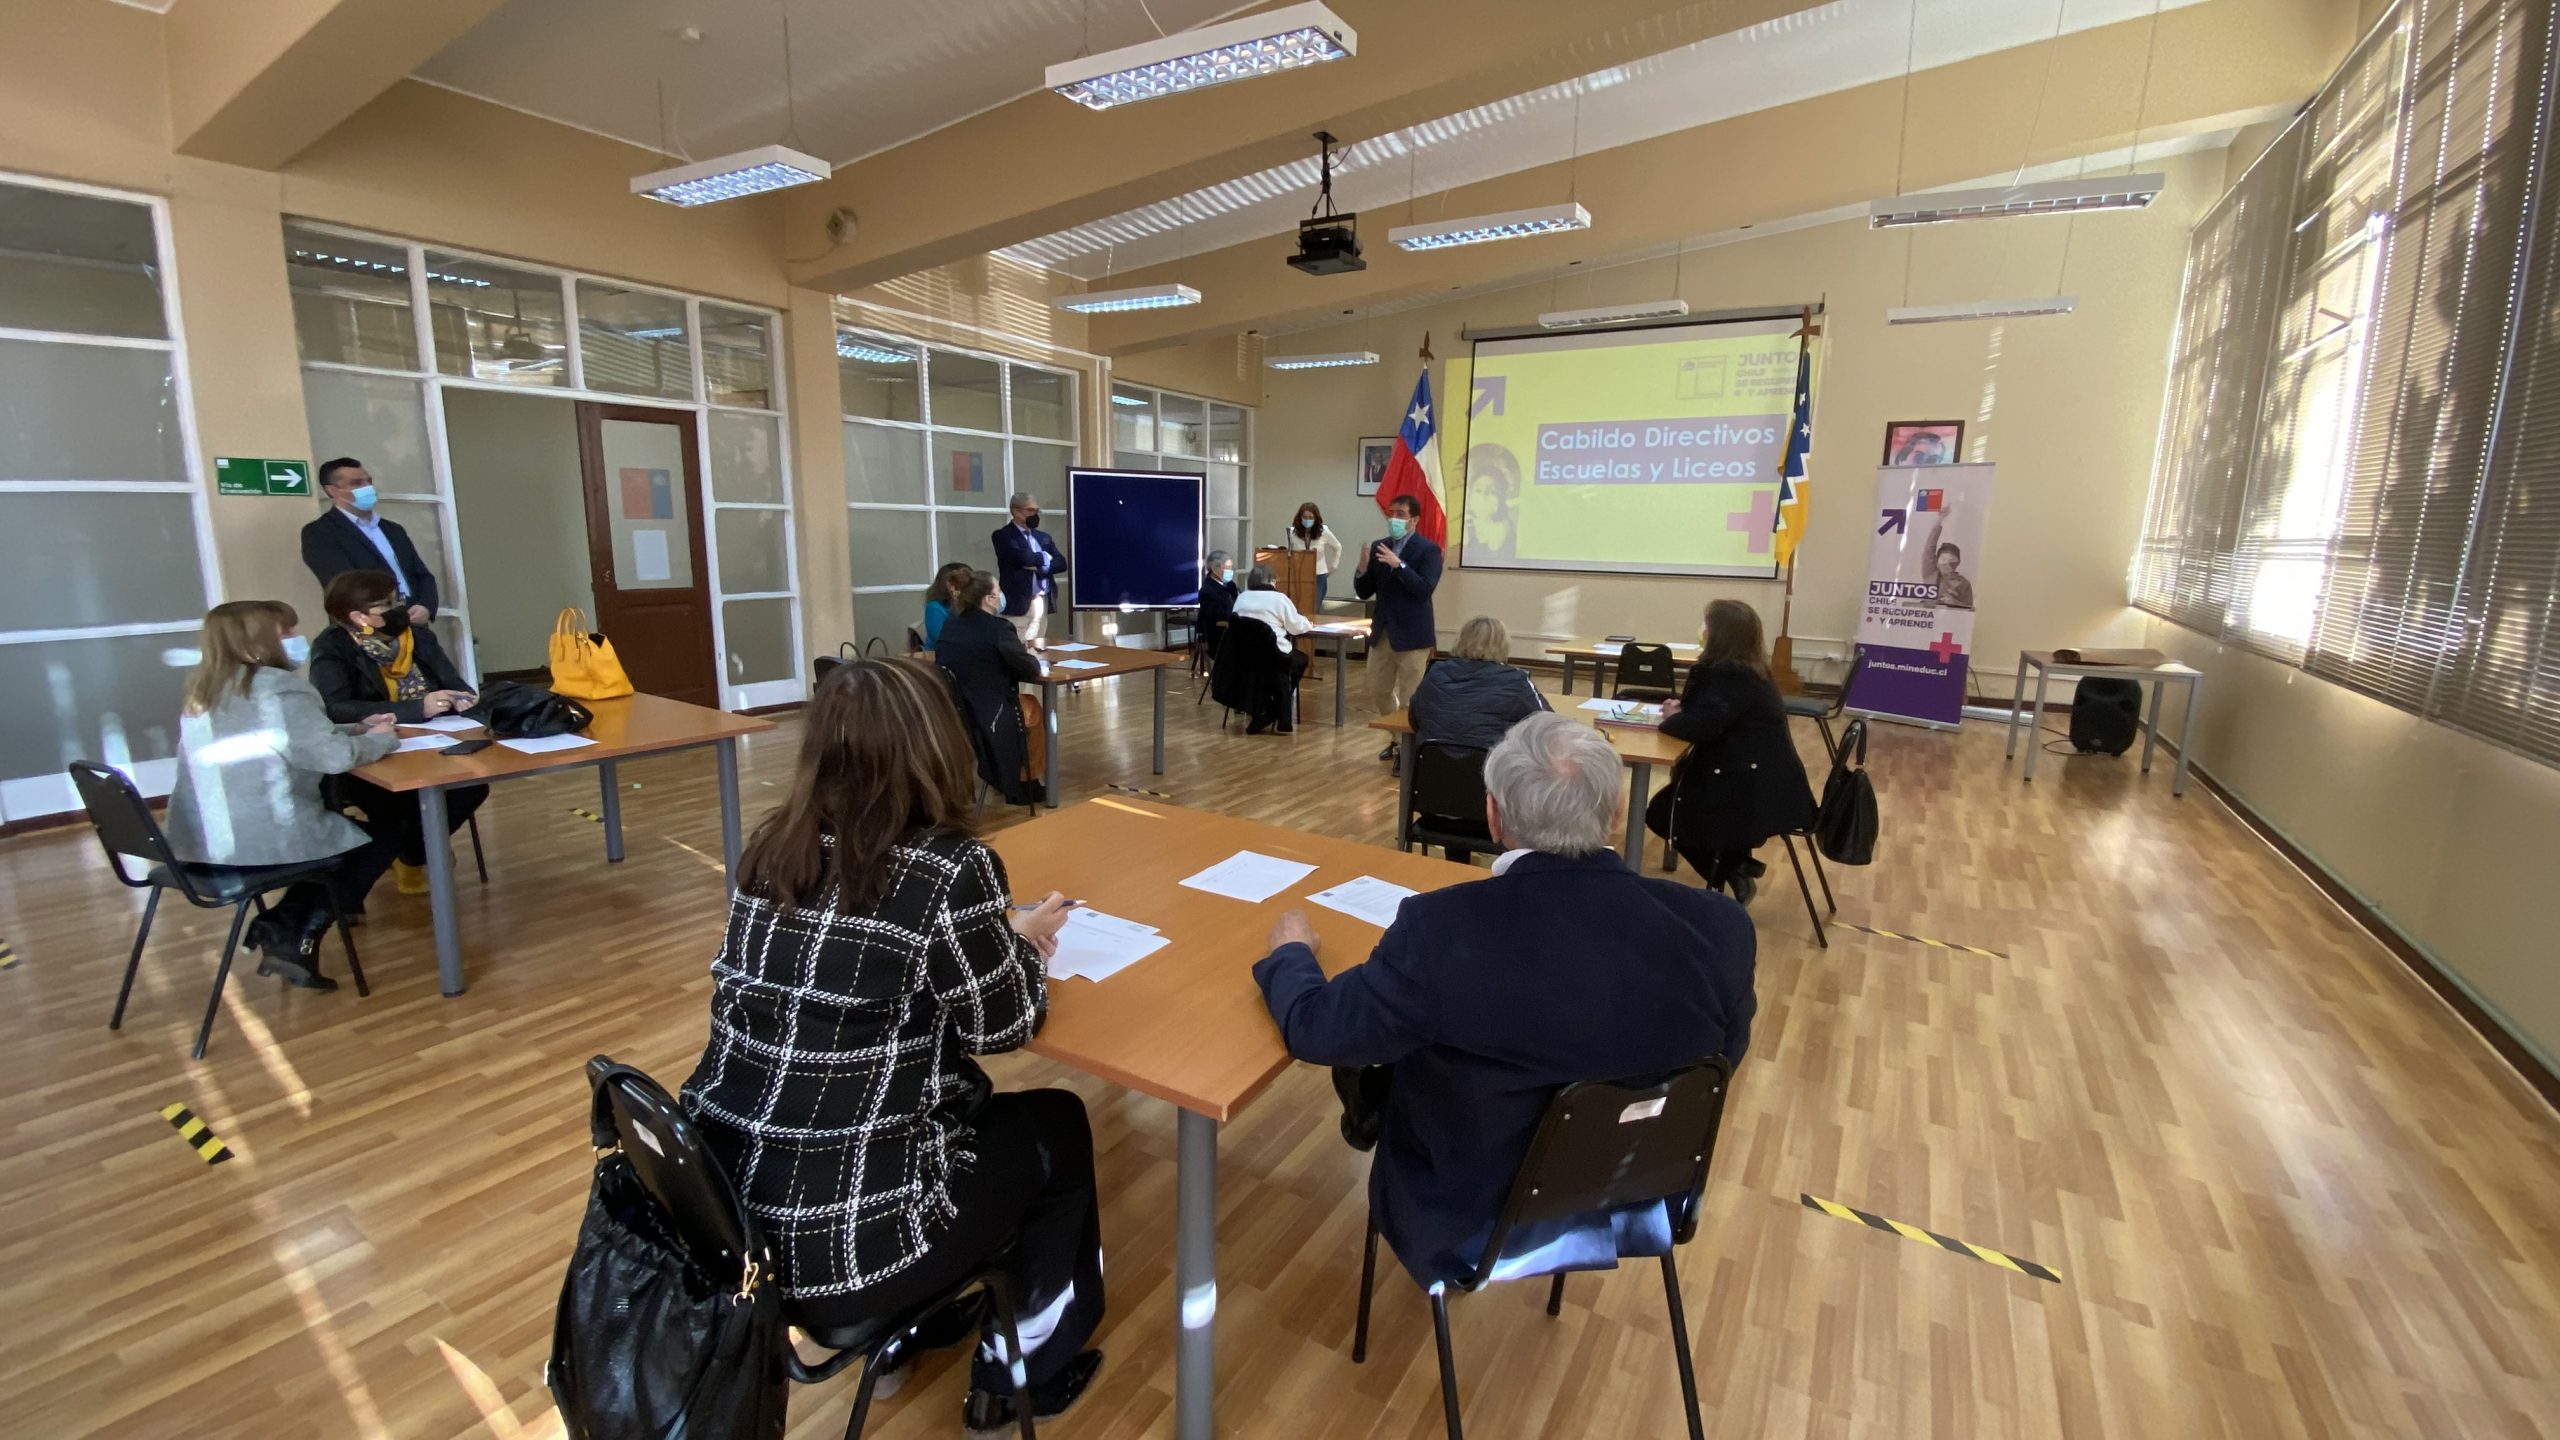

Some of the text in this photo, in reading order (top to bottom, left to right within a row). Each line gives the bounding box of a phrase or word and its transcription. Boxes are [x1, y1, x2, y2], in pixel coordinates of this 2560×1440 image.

[1738, 351, 1798, 367] JUNTO
[1541, 423, 1775, 450] Cabildo Directivos
[1539, 457, 1757, 482] Escuelas y Liceos
[1870, 582, 1938, 598] JUNTOS
[1869, 597, 1897, 605] CHILE
[1882, 608, 1934, 618] RECUPERA
[1888, 618, 1934, 629] APRENDE
[1867, 659, 1947, 676] juntos.mineduc.cl
